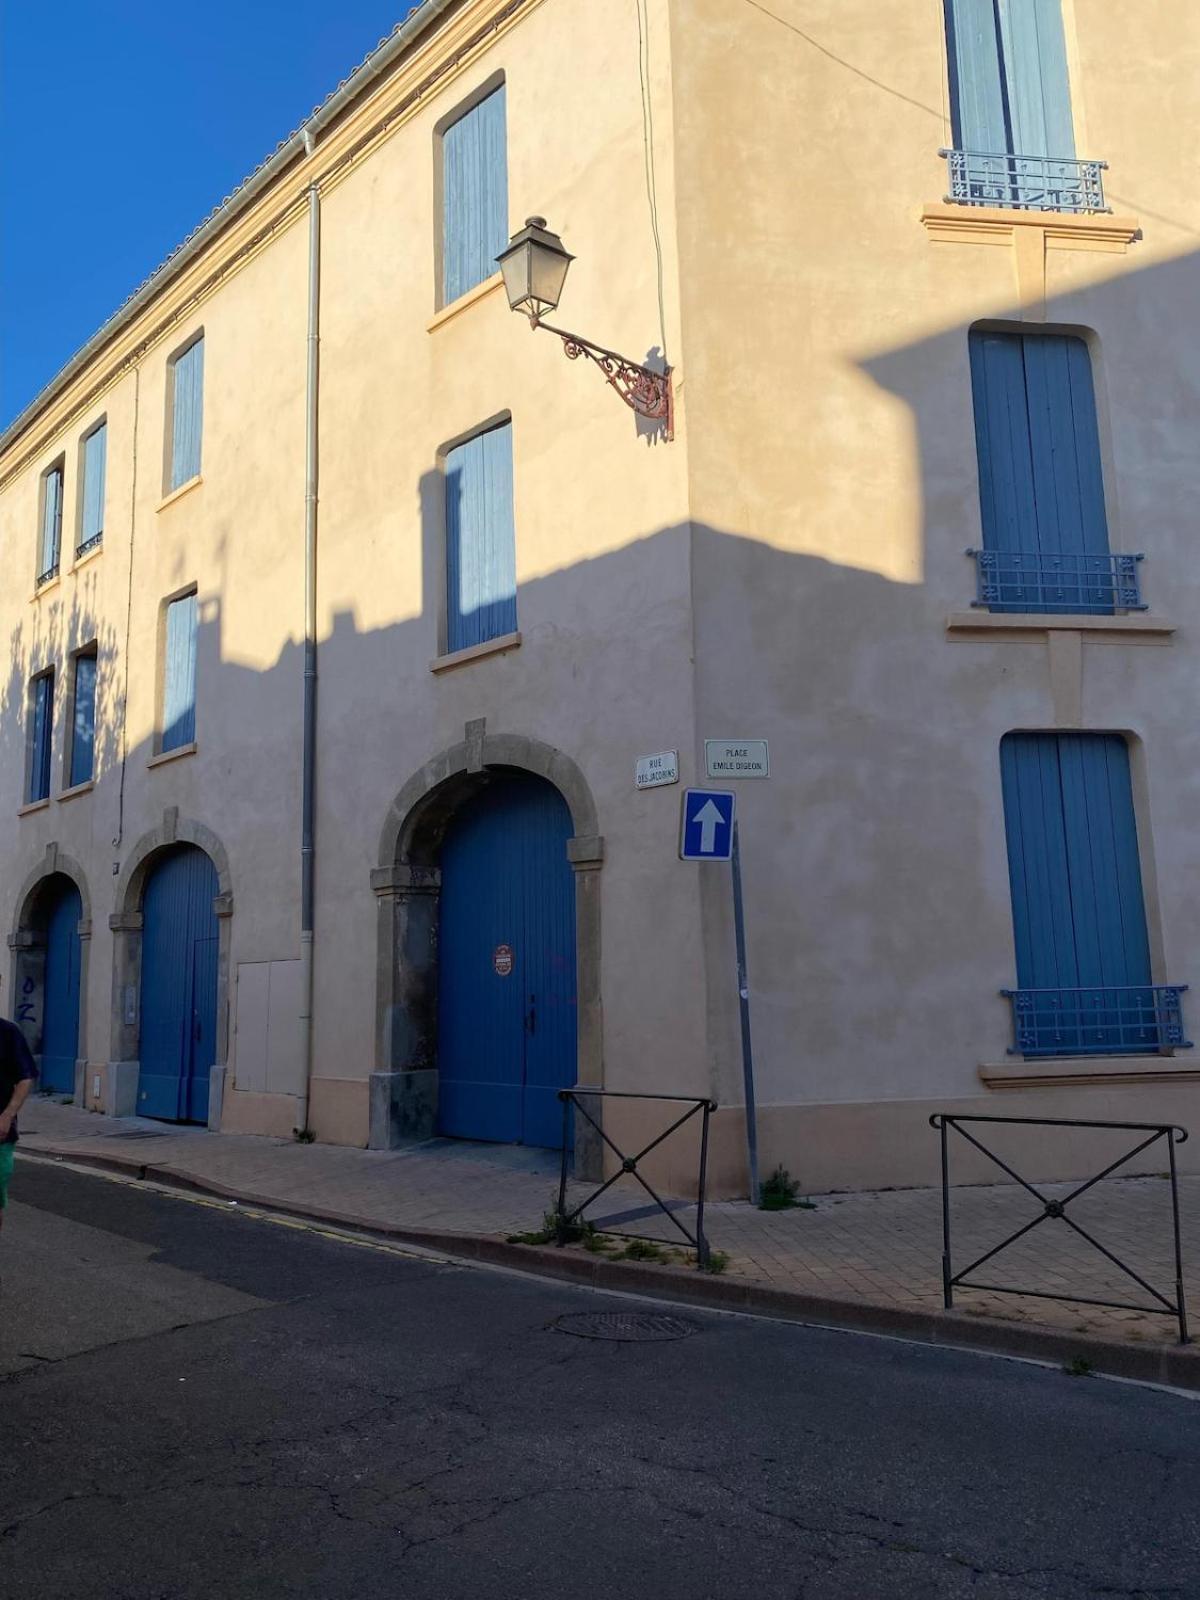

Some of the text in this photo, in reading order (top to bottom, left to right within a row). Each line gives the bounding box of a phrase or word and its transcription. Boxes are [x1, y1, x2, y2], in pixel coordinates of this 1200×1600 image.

[726, 749, 748, 757] PLACE
[649, 758, 661, 768] RUE
[713, 762, 762, 770] EMILE DIGEON
[649, 768, 675, 781] JACOBINS
